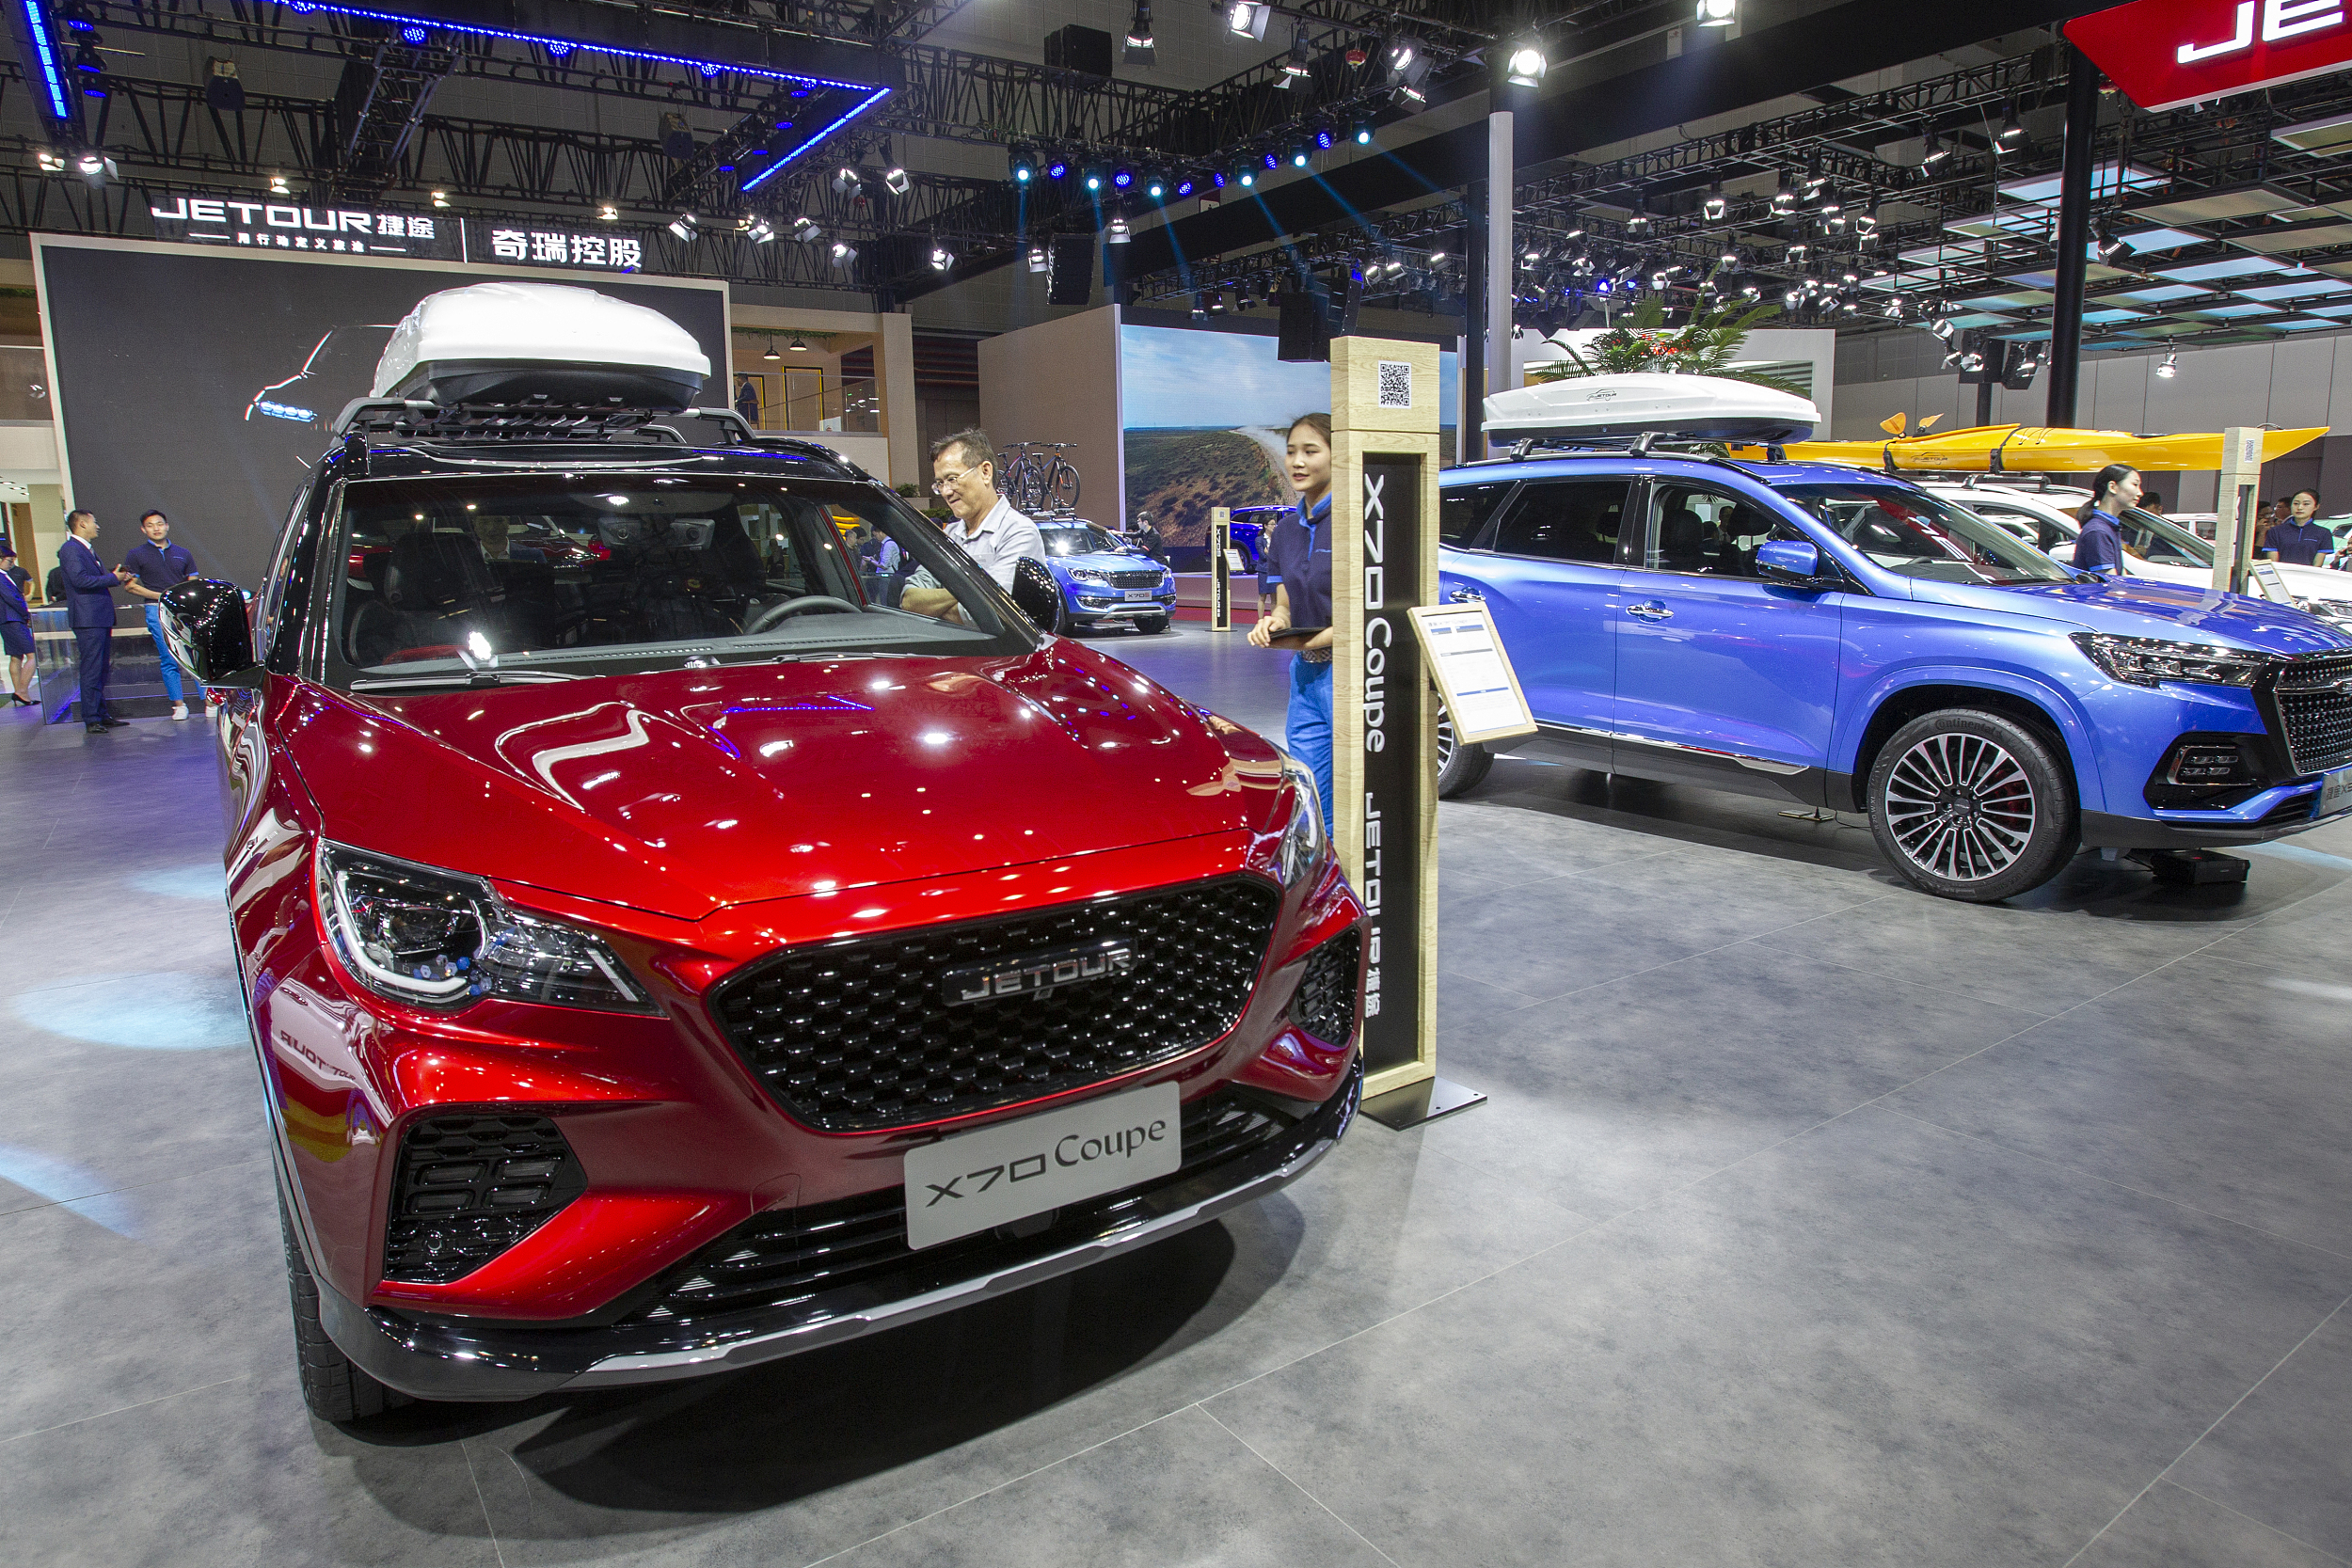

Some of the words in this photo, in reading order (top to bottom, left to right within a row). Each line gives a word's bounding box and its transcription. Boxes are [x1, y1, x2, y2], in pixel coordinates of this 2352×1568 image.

[151, 198, 373, 233] JETOUR
[376, 214, 435, 239] 捷途
[492, 230, 642, 268] 奇瑞控股
[1364, 473, 1384, 610] X70
[1362, 617, 1392, 752] Coupe
[961, 947, 1131, 1001] JETOUR
[925, 1152, 1047, 1208] X70
[1055, 1119, 1167, 1167] Coupe
